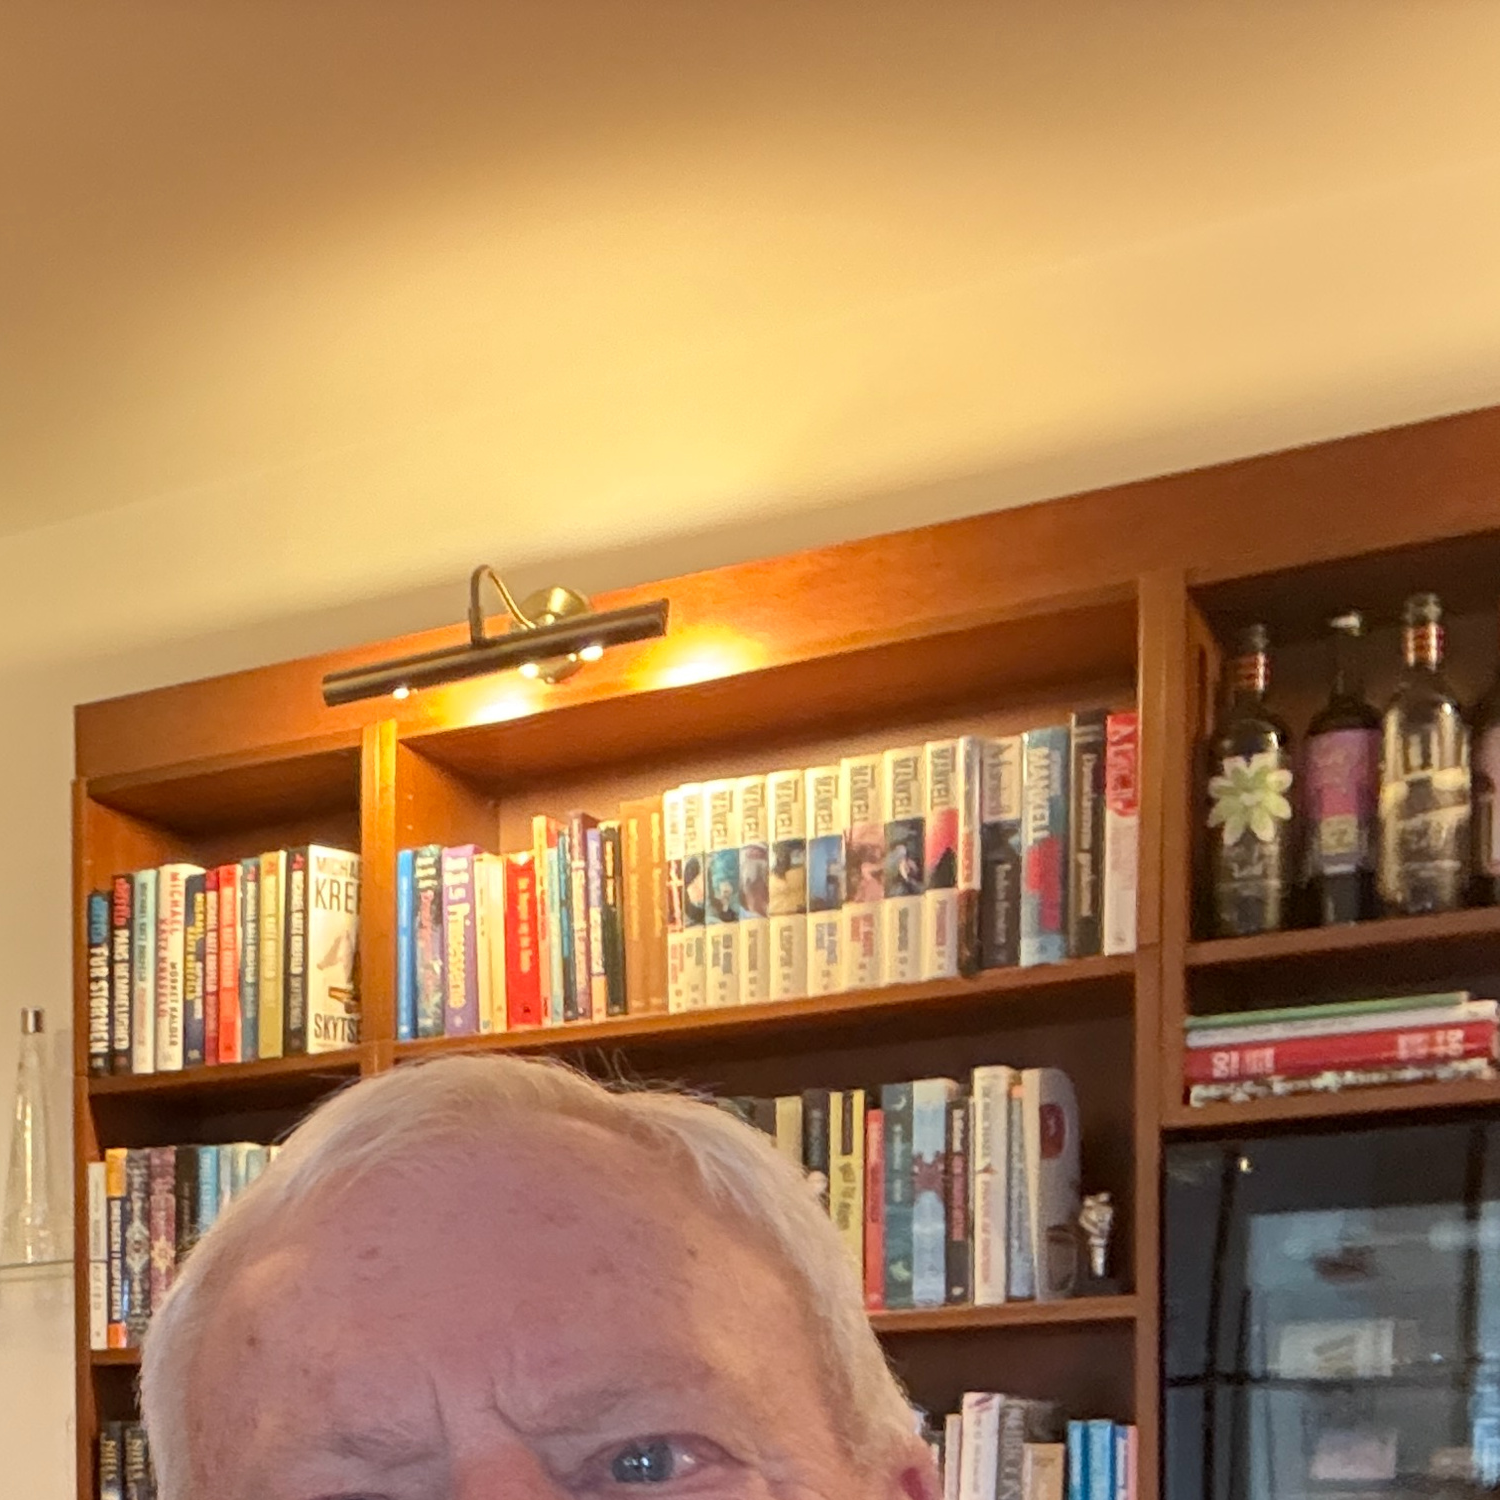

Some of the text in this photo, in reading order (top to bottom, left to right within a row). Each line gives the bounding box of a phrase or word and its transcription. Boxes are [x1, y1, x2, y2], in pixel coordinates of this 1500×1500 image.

[169, 871, 181, 936] MICHAEL
[315, 877, 361, 916] KRE
[314, 1013, 360, 1044] SKYTS
